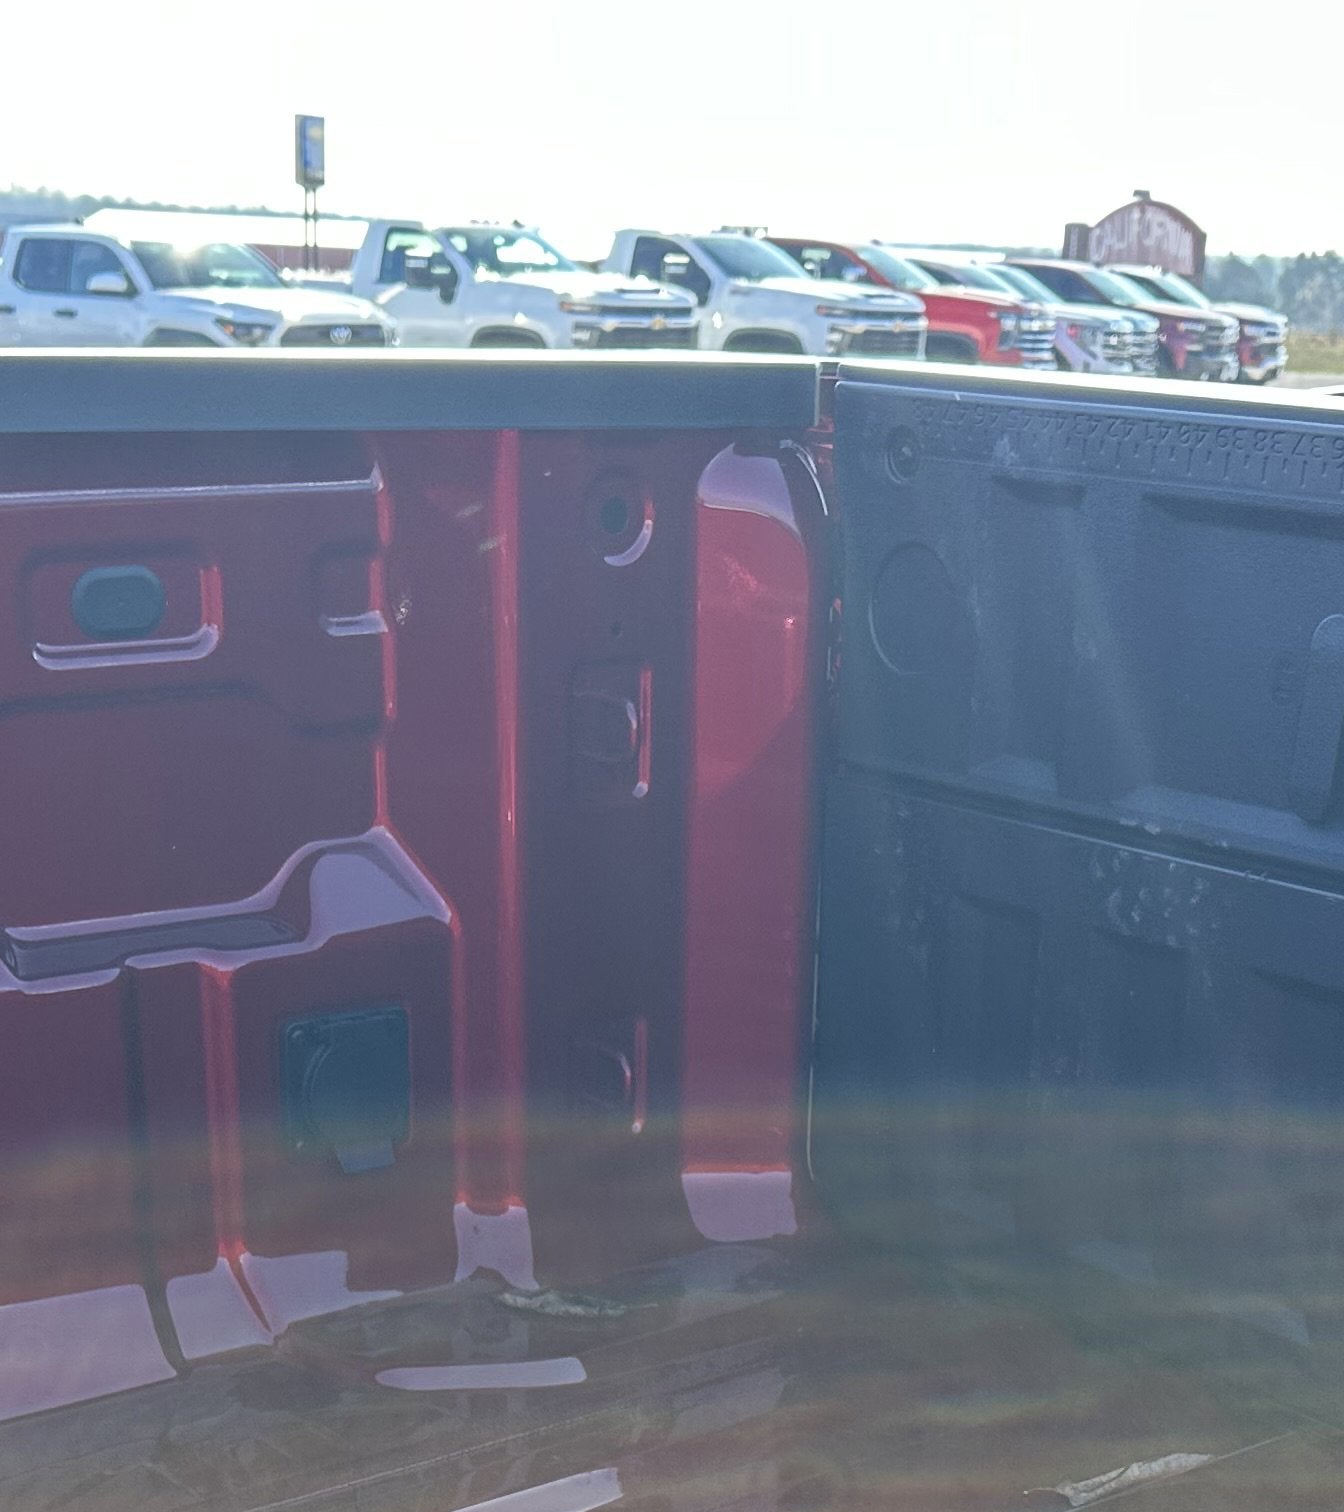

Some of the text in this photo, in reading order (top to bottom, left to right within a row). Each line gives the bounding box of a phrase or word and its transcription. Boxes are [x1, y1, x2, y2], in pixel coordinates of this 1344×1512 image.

[974, 406, 1001, 427] 46
[1074, 414, 1100, 438] 43
[1107, 417, 1135, 441] 42
[1143, 420, 1172, 445] 41
[1216, 428, 1247, 450] 39
[1254, 430, 1286, 455] 38
[1292, 434, 1325, 459] 37
